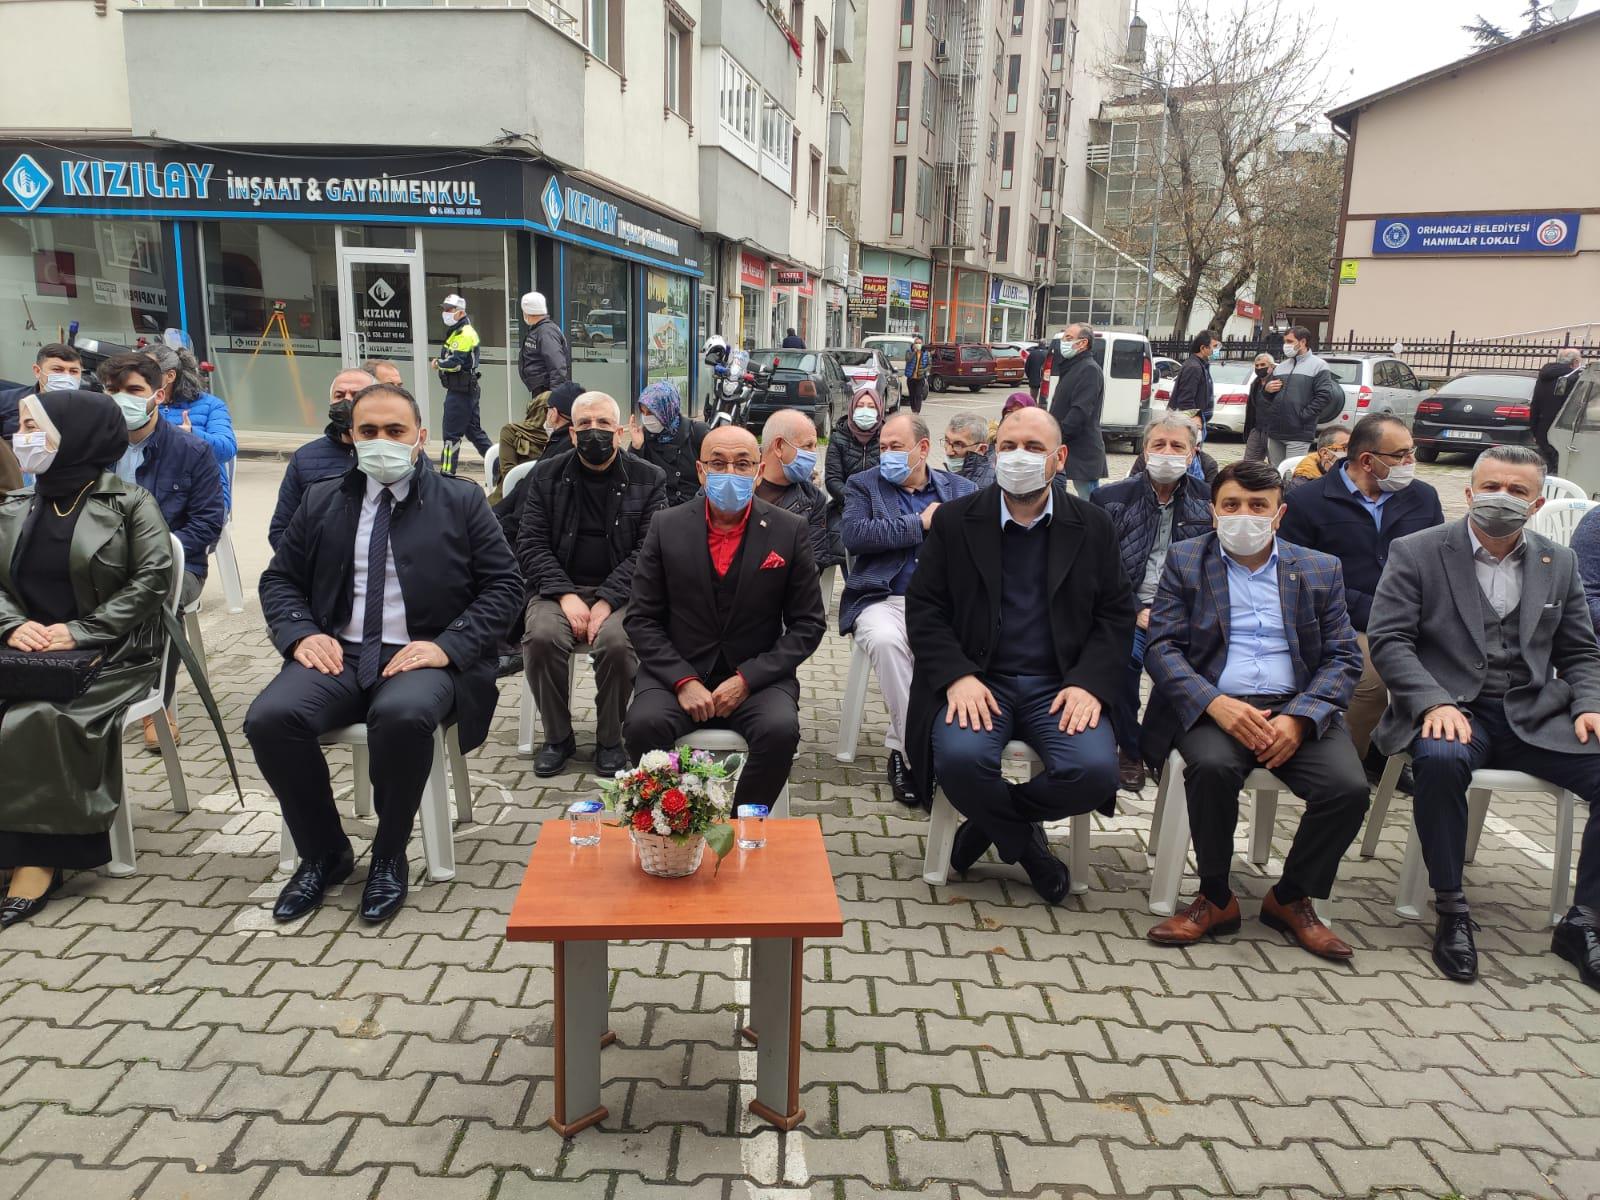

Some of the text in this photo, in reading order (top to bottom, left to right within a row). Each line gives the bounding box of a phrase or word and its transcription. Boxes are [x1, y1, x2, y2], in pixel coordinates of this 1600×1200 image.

[61, 160, 481, 206] KIZILAY İNŞAAT & GAYRİMENKUL
[565, 186, 618, 236] KIZILAY
[1417, 222, 1530, 235] ORHANGAZİ BELEDİYESİ
[1422, 234, 1520, 247] HANIMLAR LOKALİ
[864, 283, 887, 291] EMLAK
[363, 308, 402, 319] KIZILAY
